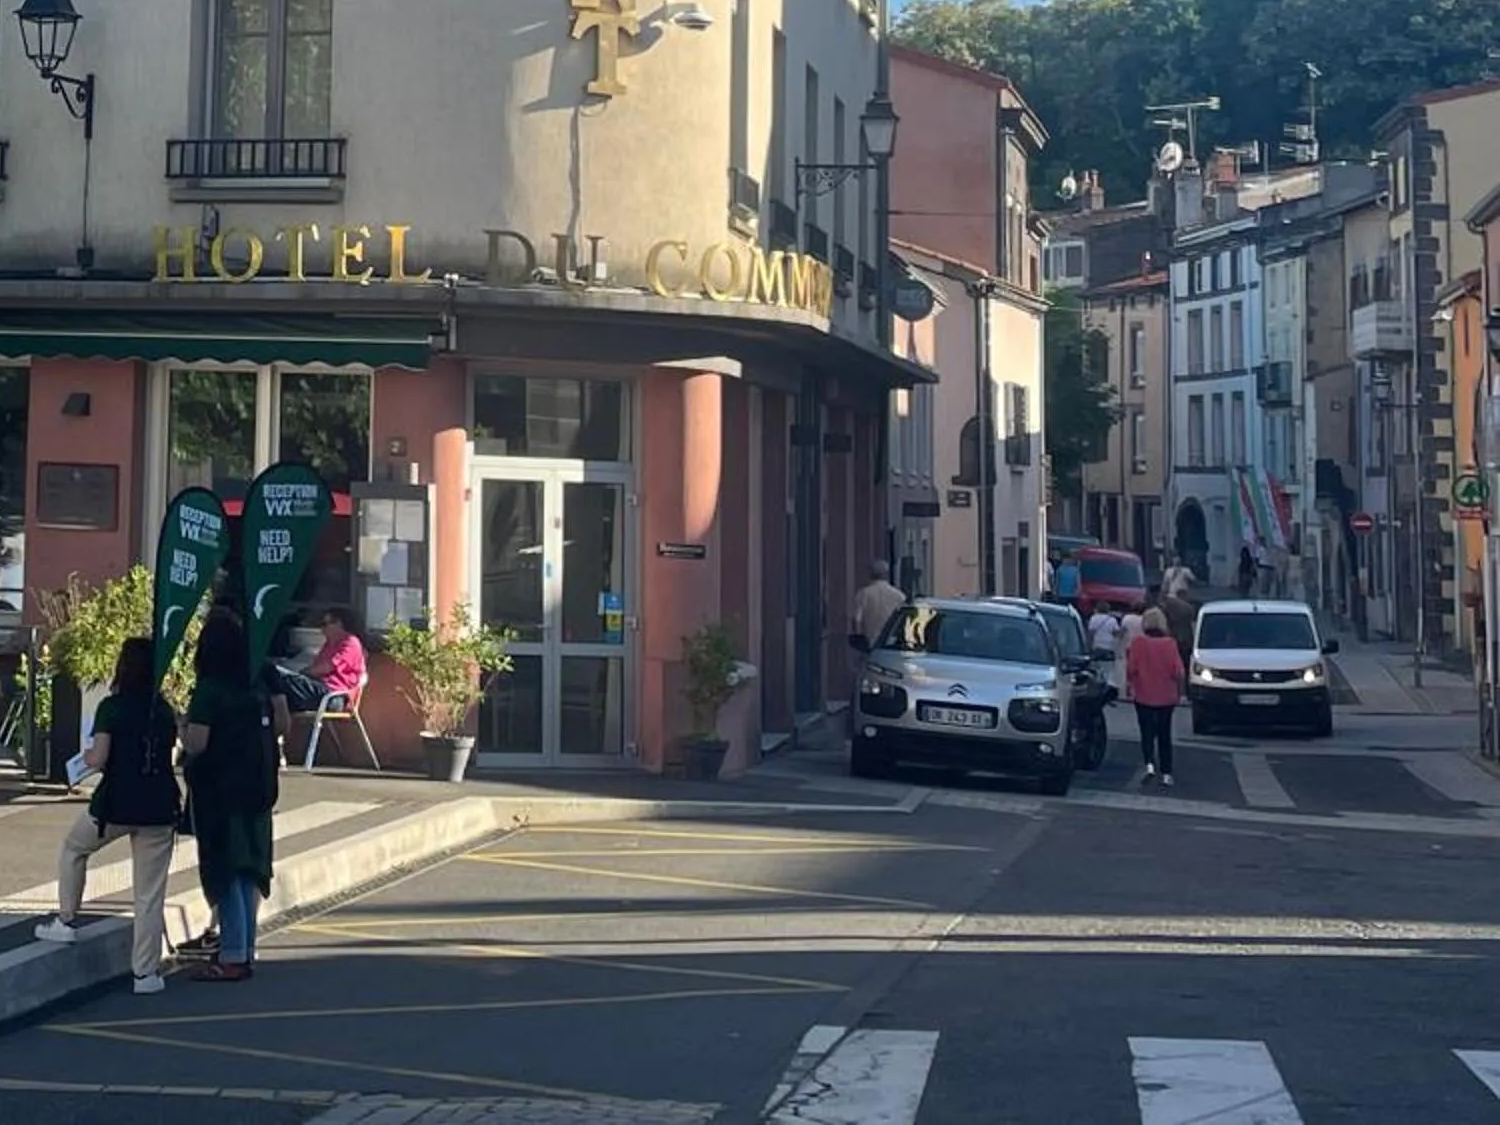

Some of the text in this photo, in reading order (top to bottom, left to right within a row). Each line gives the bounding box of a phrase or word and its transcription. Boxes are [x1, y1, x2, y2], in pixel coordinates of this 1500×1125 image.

[152, 225, 433, 283] HOTEL
[483, 229, 605, 296] DU
[263, 484, 318, 498] RECEPTION
[259, 529, 291, 546] NEED
[173, 548, 197, 572] NEED
[257, 546, 294, 564] HELP?
[169, 565, 199, 590] HELP?
